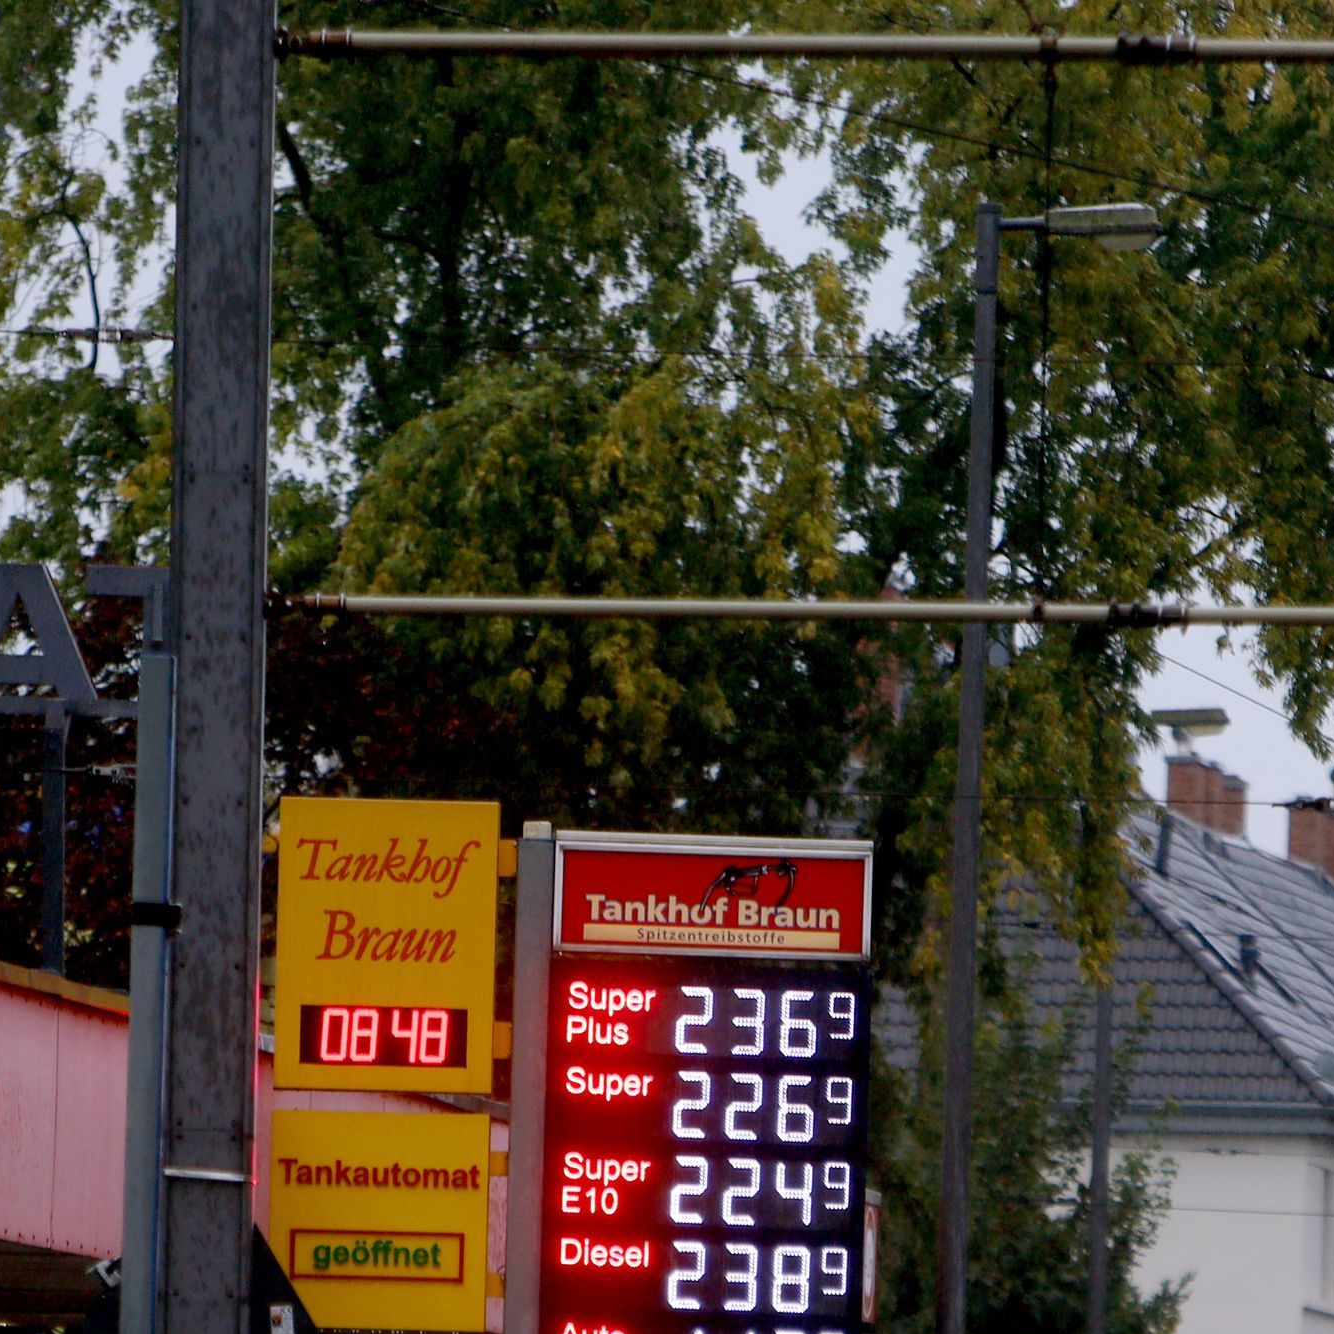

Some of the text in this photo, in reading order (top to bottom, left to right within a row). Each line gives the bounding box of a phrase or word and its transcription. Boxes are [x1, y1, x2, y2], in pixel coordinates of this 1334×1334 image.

[295, 838, 481, 898] Tankhof
[586, 893, 840, 929] Tankhof Braun
[315, 909, 457, 964] Braun
[636, 927, 786, 945] Spitzentreibstoffe
[568, 981, 656, 1015] Super
[320, 1008, 378, 1062] 08
[566, 1015, 629, 1046] Plus
[565, 1066, 653, 1100] Super
[277, 1158, 480, 1190] Tankautomat
[563, 1151, 651, 1185] Super
[561, 1187, 618, 1215] E10
[313, 1241, 442, 1268] geöffnet
[560, 1238, 650, 1268] Diesel
